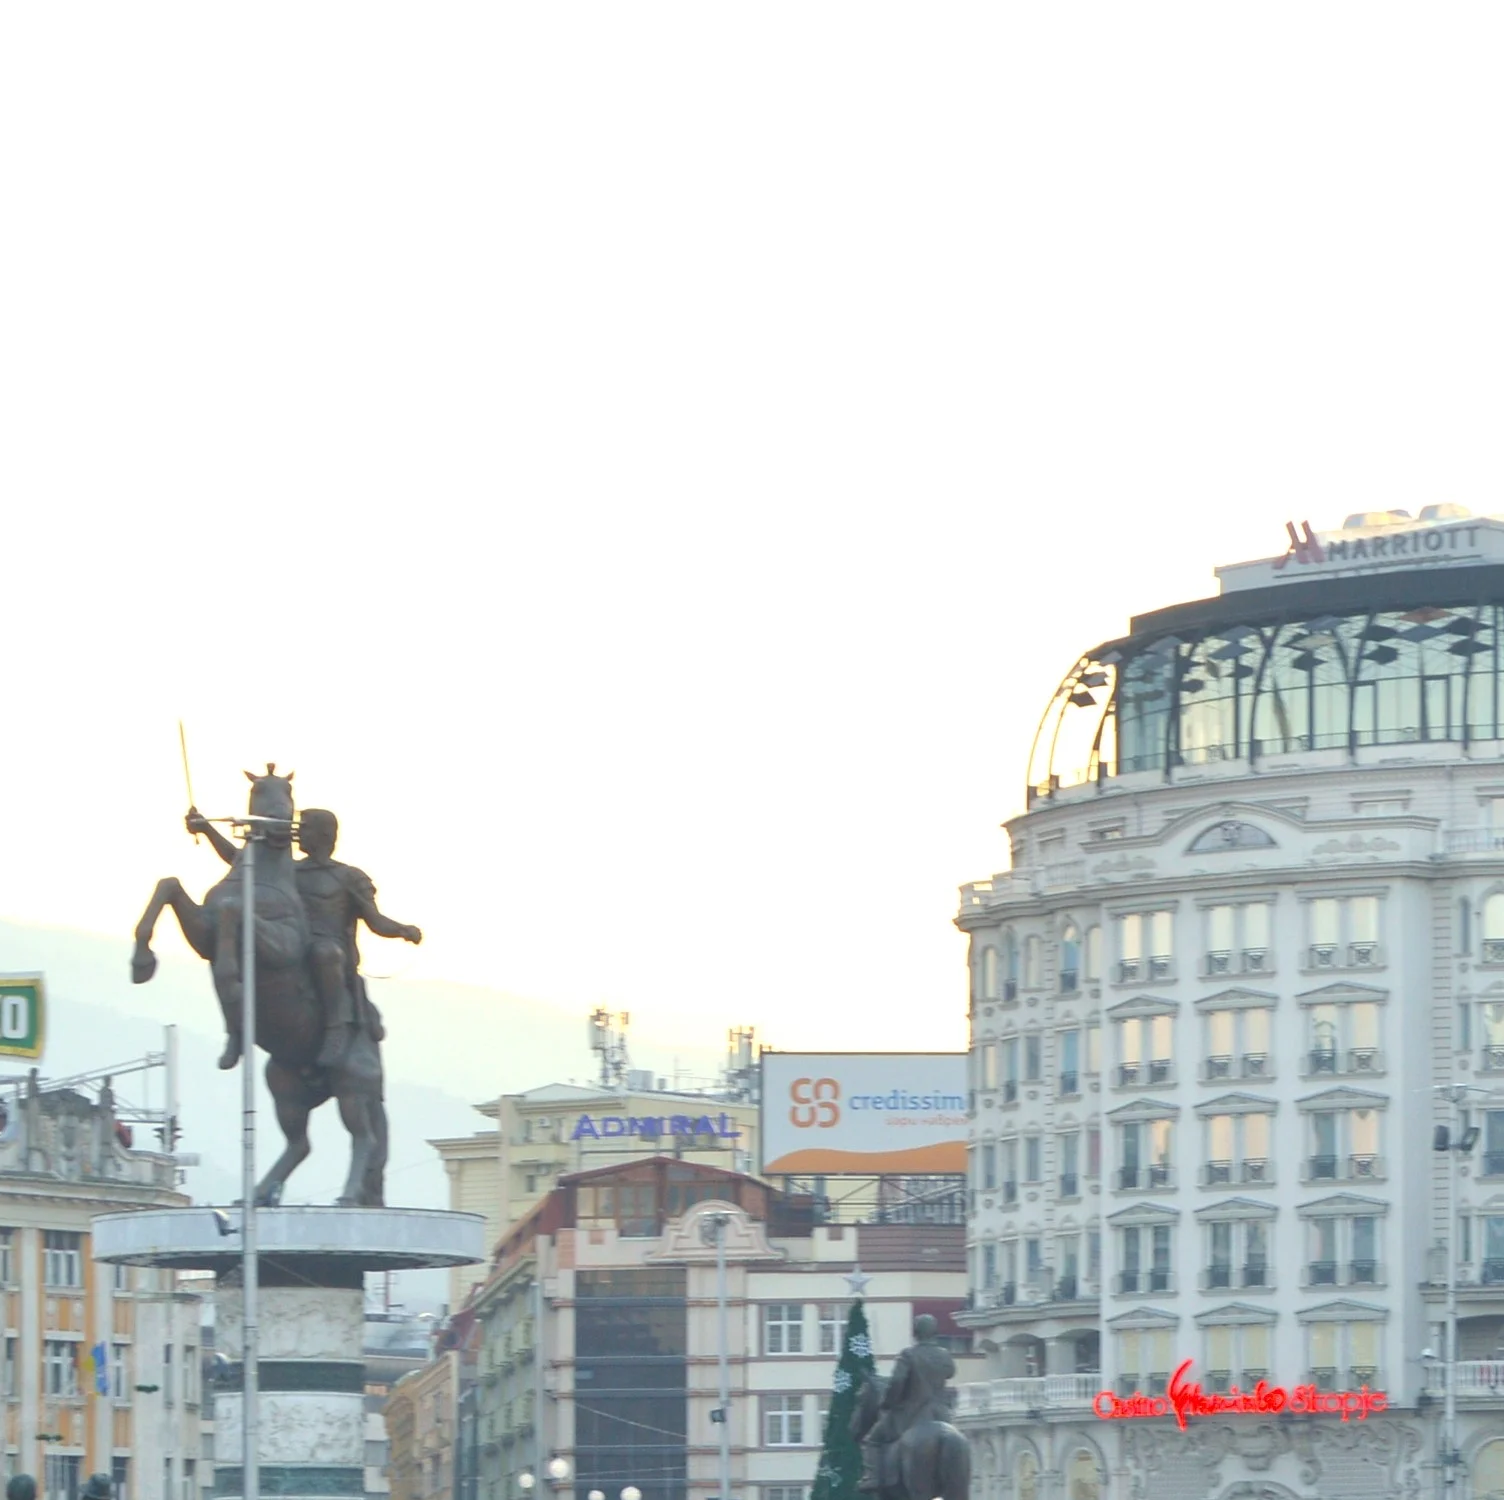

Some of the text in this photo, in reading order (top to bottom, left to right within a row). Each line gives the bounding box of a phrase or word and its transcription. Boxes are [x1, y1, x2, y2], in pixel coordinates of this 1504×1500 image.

[1327, 526, 1480, 562] MARRIOTT
[849, 1090, 968, 1110] credissim
[570, 1112, 743, 1140] ADMIRAL
[1093, 1391, 1168, 1419] Casino
[1289, 1383, 1390, 1422] Skopje
